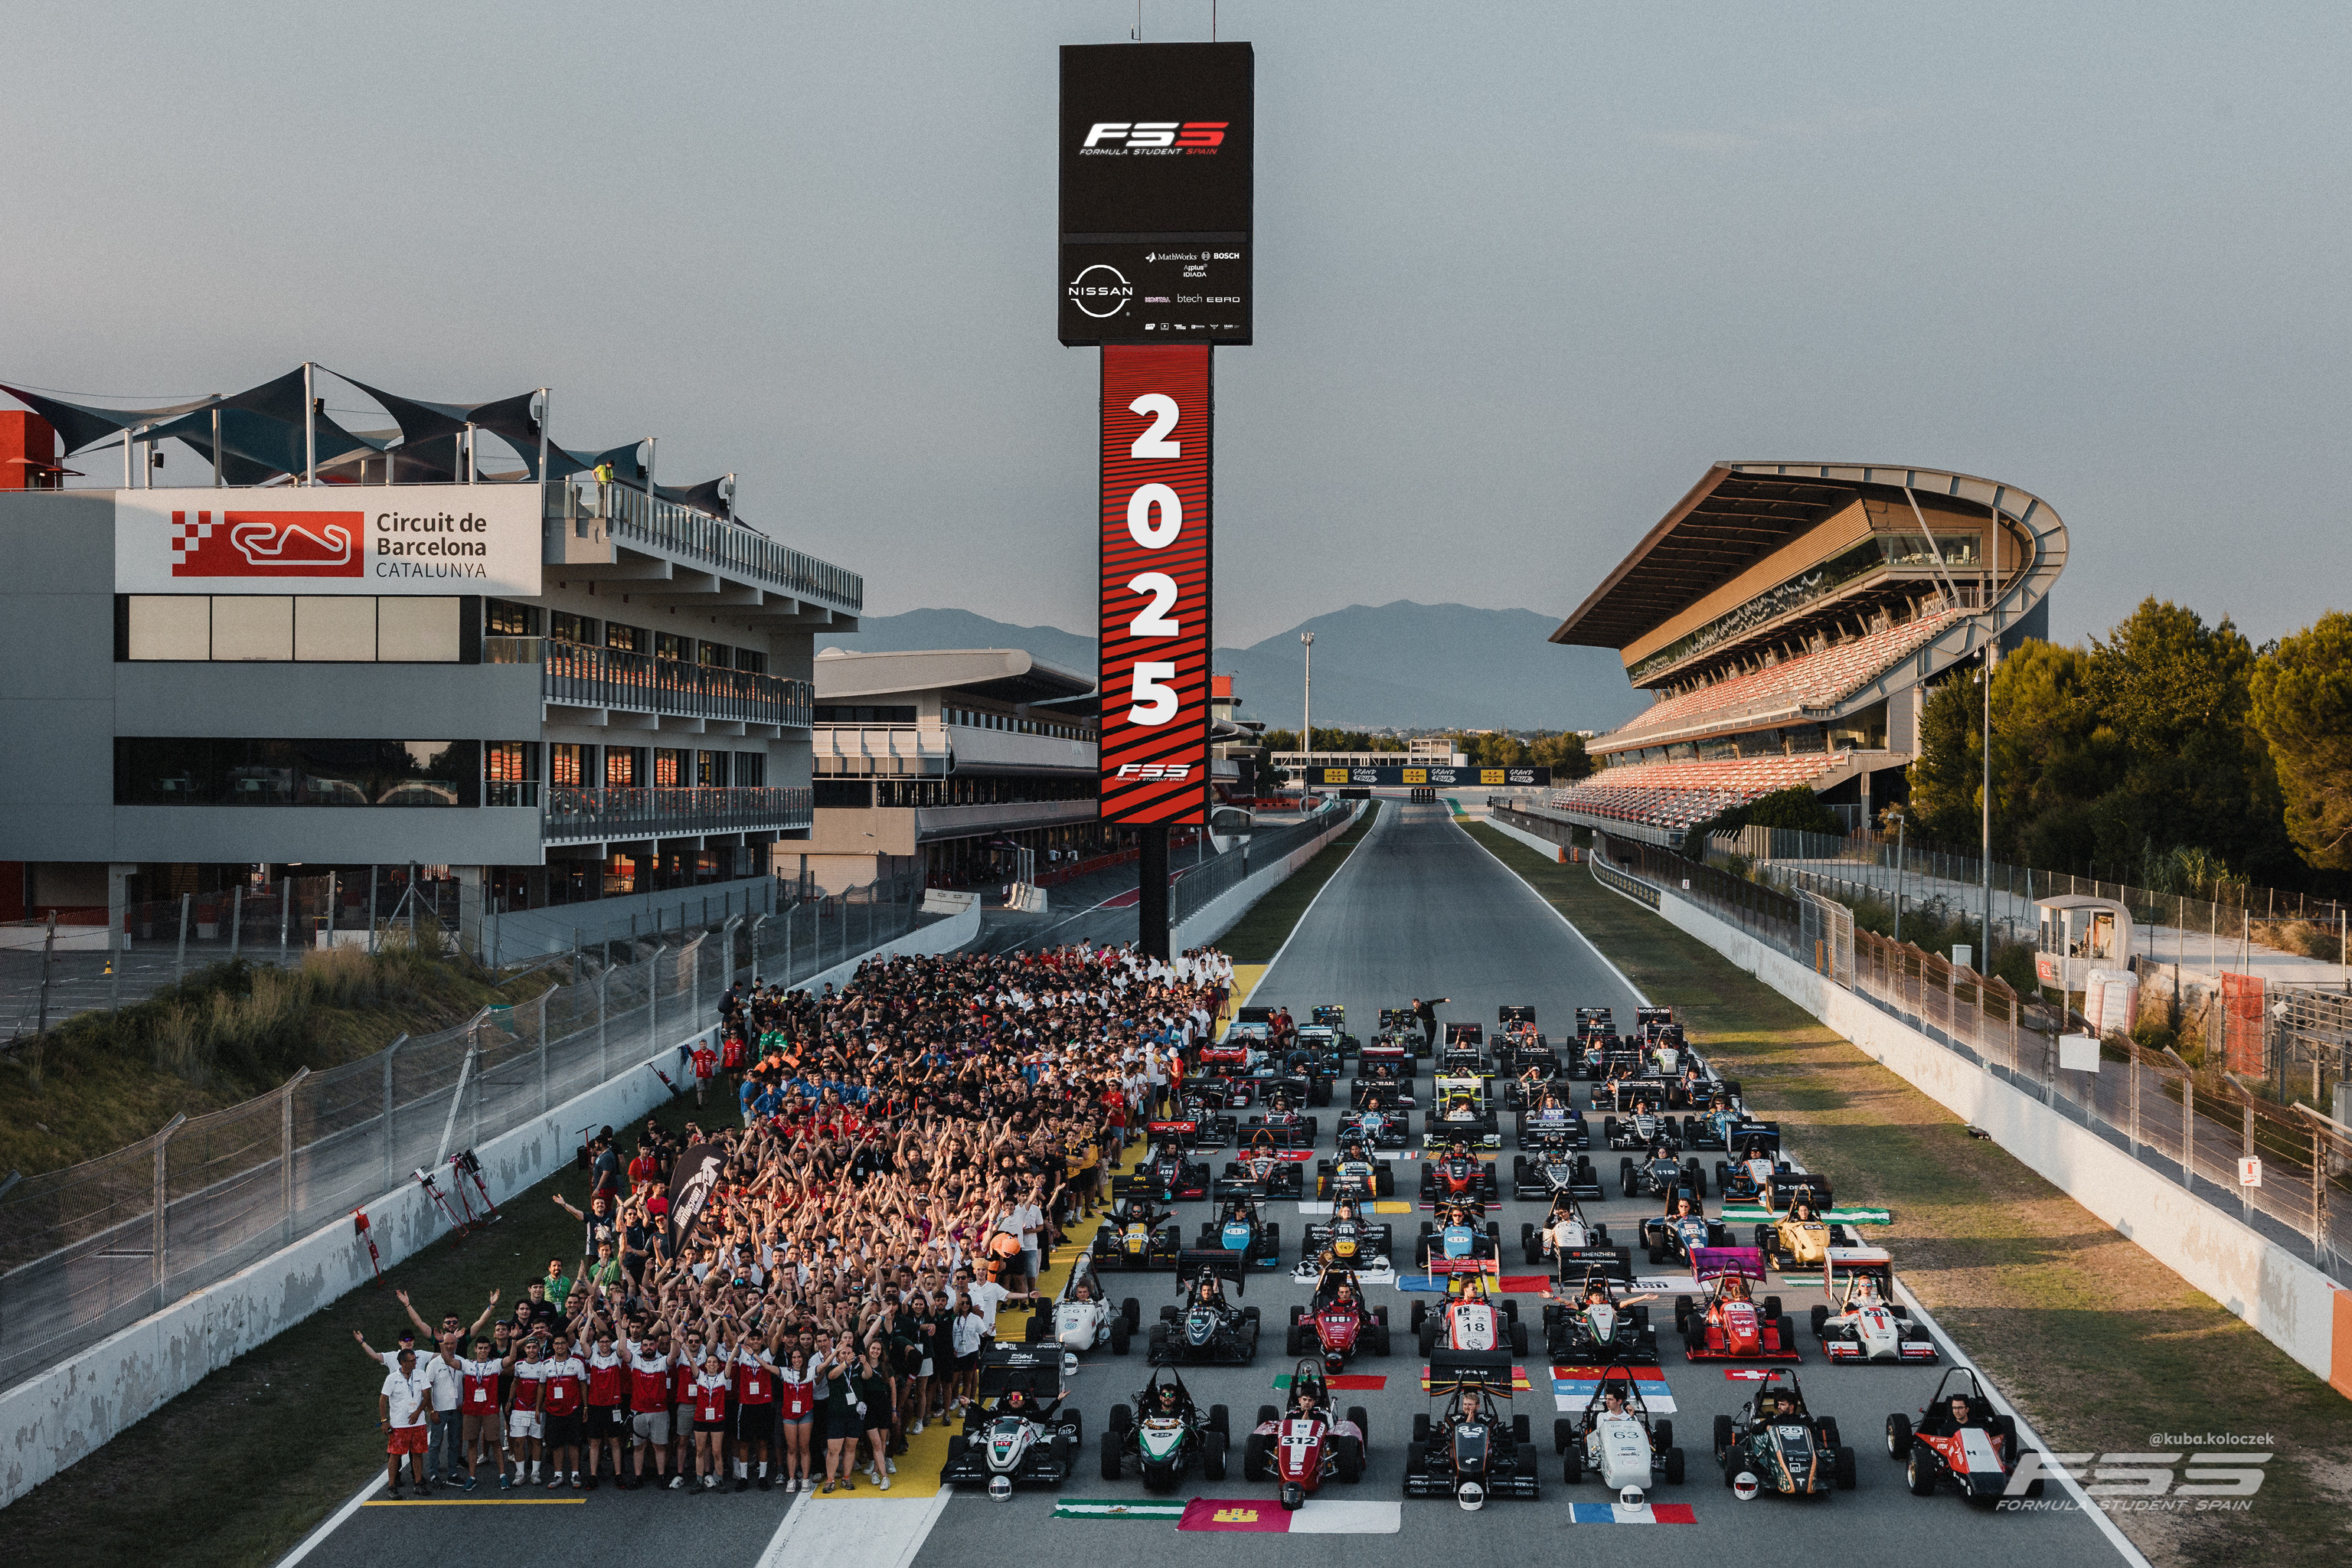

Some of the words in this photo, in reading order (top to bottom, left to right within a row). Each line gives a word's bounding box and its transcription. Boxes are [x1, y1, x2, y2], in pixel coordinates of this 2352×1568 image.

[1083, 122, 1230, 147] FSS
[1158, 253, 1197, 261] MathWorks
[1068, 287, 1133, 296] NISSAN
[1177, 293, 1203, 303] btech
[377, 512, 456, 533] Circuit
[459, 511, 487, 533] de
[377, 537, 486, 557] Barcelona
[376, 562, 487, 579] CATALUNYA
[1117, 763, 1191, 777] FSS
[678, 1185, 702, 1230] MOTORSPORT
[1463, 1322, 1485, 1332] 18
[1613, 1431, 1639, 1439] 63
